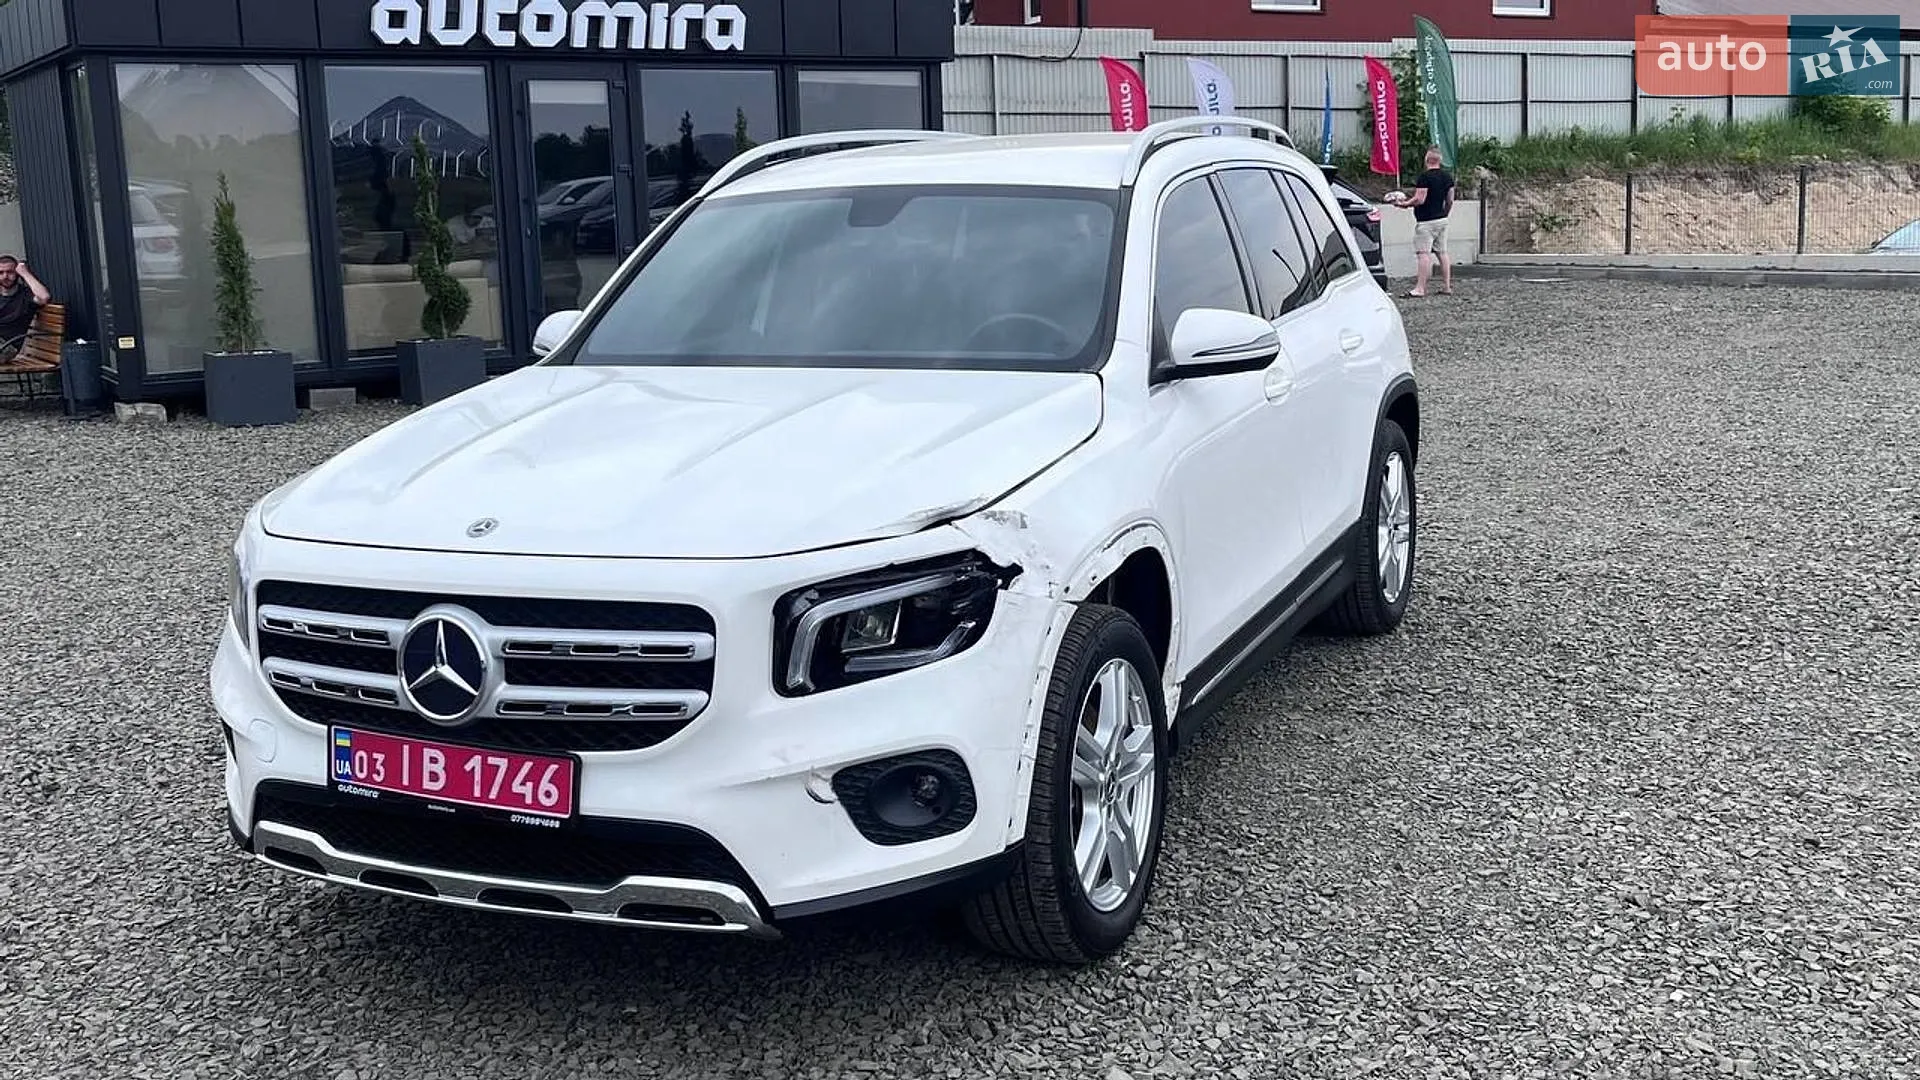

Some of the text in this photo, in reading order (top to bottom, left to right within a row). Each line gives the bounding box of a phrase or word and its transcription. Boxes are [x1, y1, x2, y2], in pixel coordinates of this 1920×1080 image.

[371, 0, 747, 50] automira
[336, 759, 352, 775] UA
[355, 749, 386, 782] 03
[463, 754, 560, 807] 1746
[337, 783, 379, 799] automira
